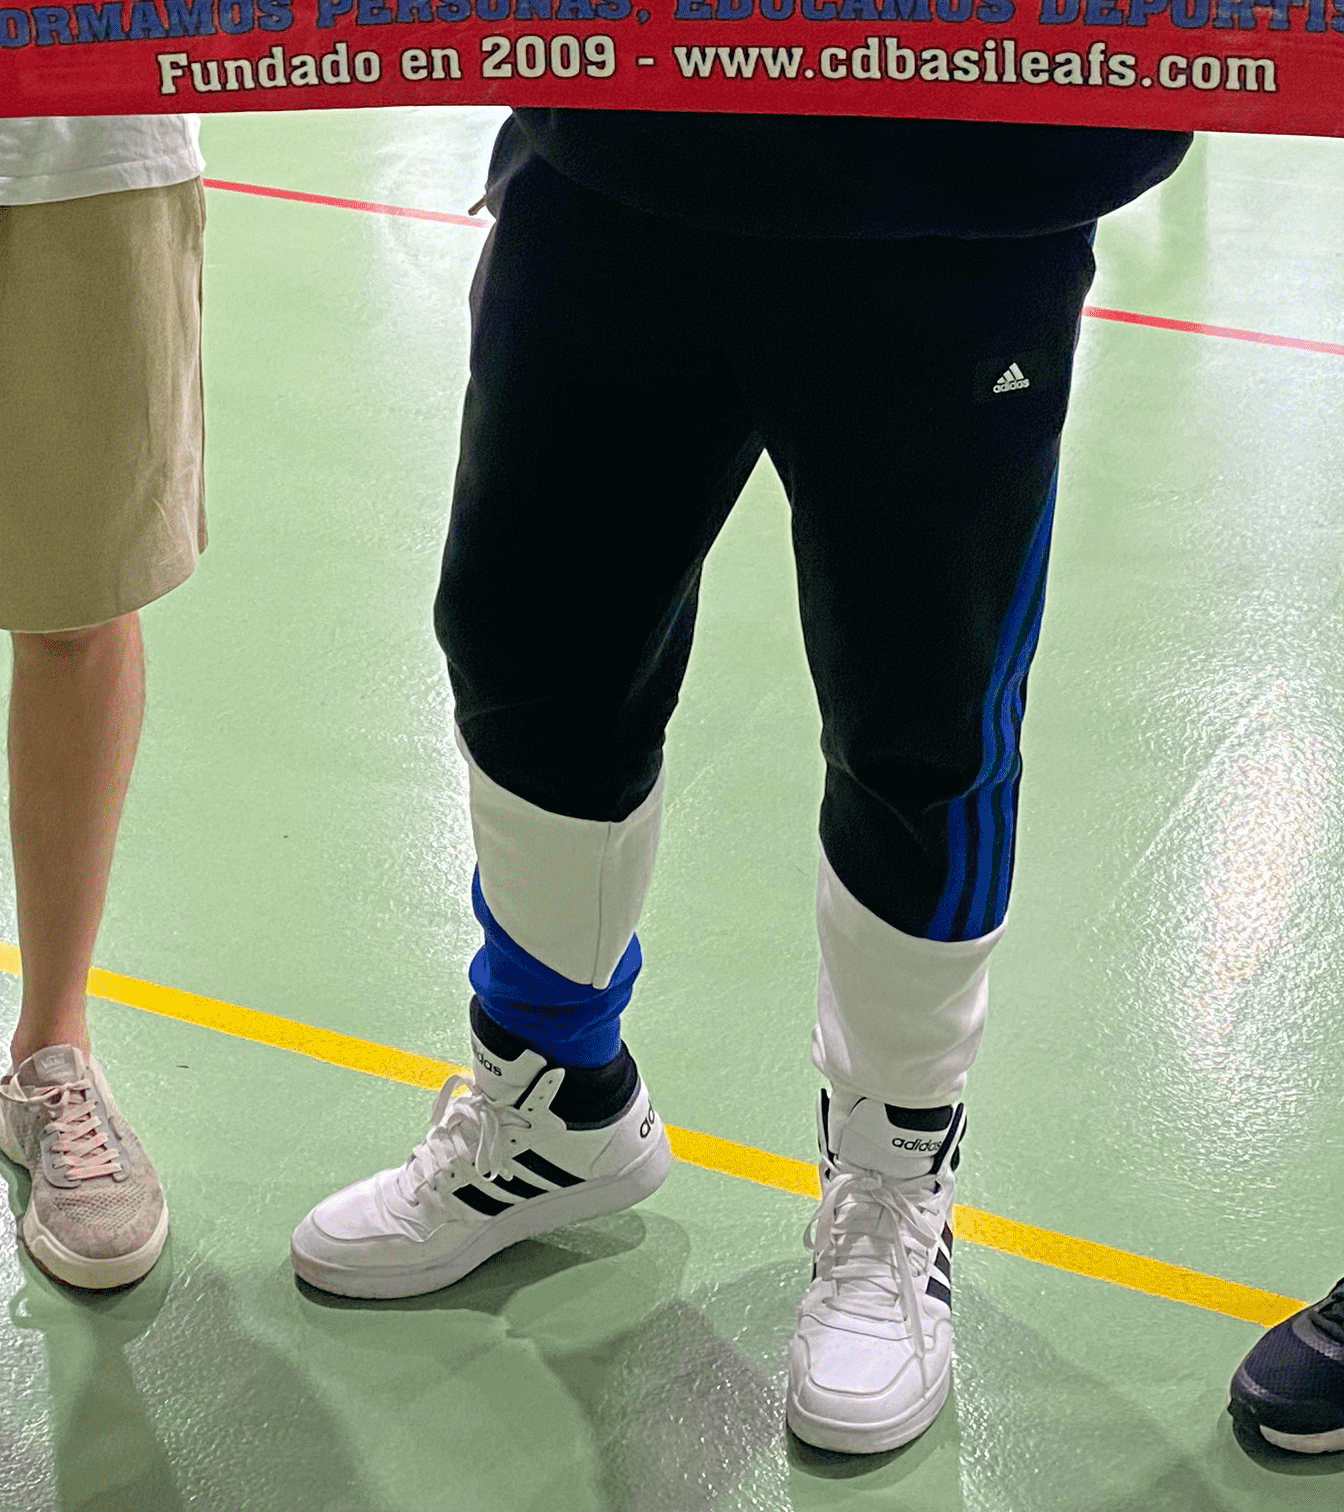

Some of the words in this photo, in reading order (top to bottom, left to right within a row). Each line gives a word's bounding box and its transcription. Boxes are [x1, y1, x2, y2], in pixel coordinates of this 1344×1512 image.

[158, 42, 381, 95] Fundado
[401, 46, 462, 81] en
[480, 34, 617, 80] 2009
[674, 37, 1278, 93] www.cdbasileafs.com
[993, 378, 1030, 393] adidas
